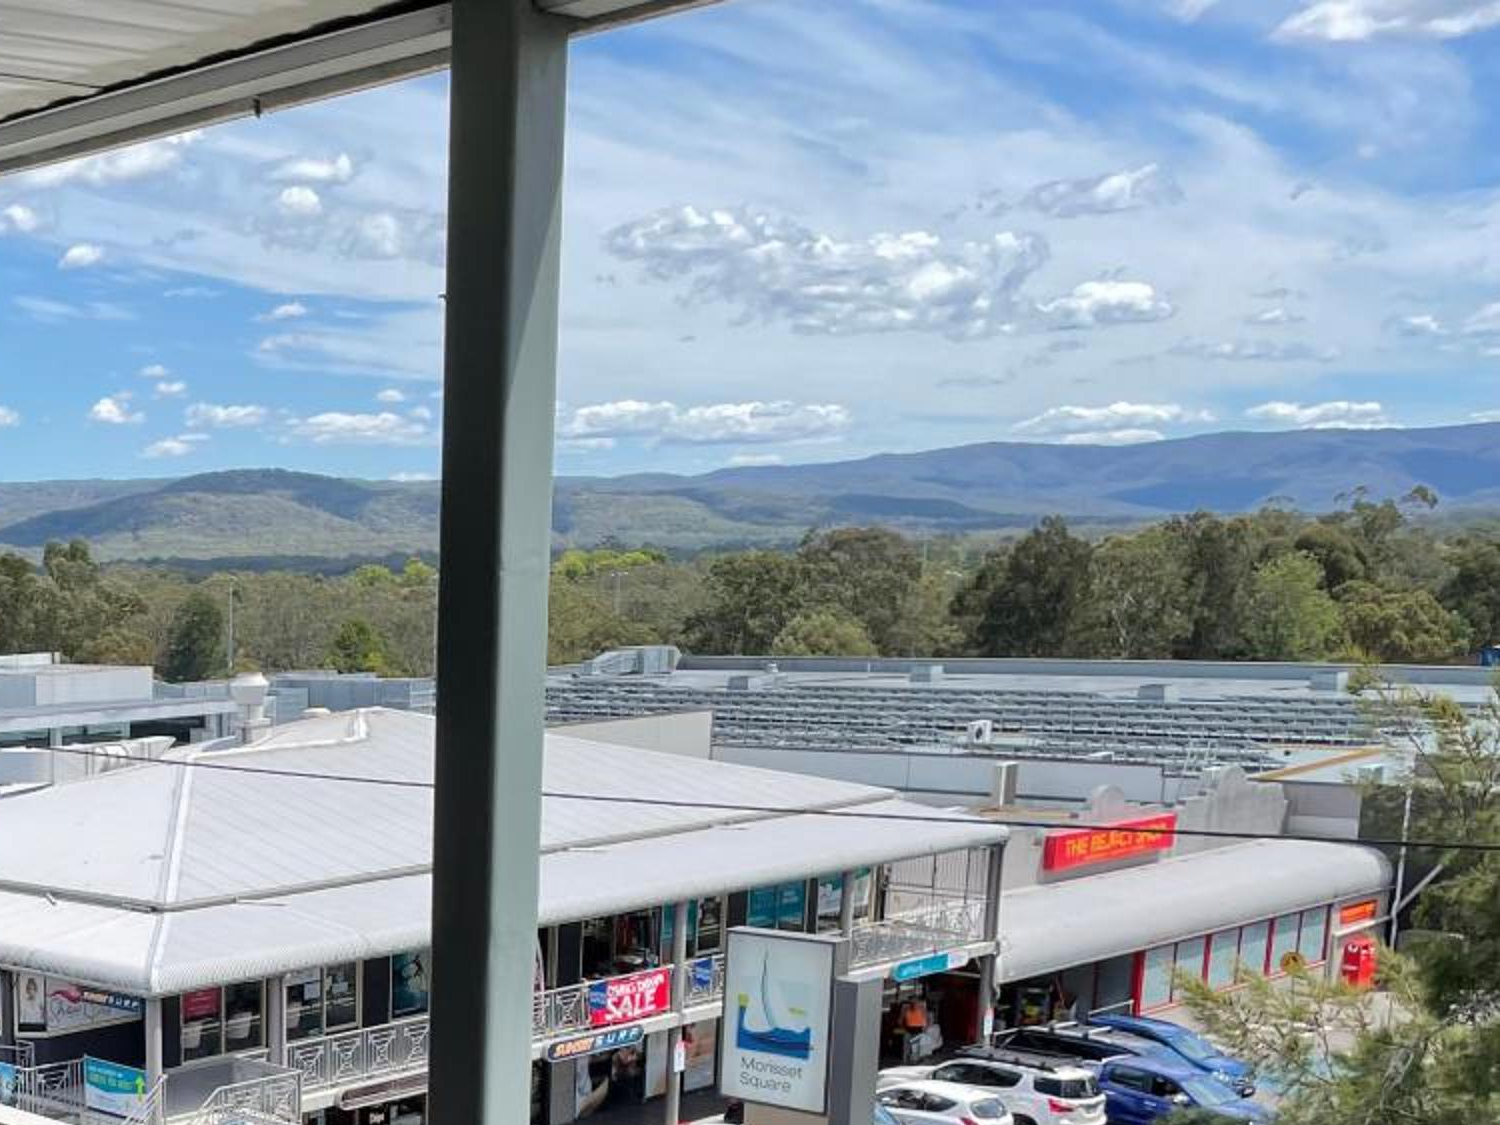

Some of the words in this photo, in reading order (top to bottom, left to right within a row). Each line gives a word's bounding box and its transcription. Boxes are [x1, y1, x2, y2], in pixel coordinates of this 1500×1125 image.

[1065, 836, 1088, 855] THE
[605, 992, 657, 1020] SALE
[595, 1027, 639, 1047] SURF
[740, 1056, 803, 1080] Morisset
[739, 1072, 791, 1093] Square
